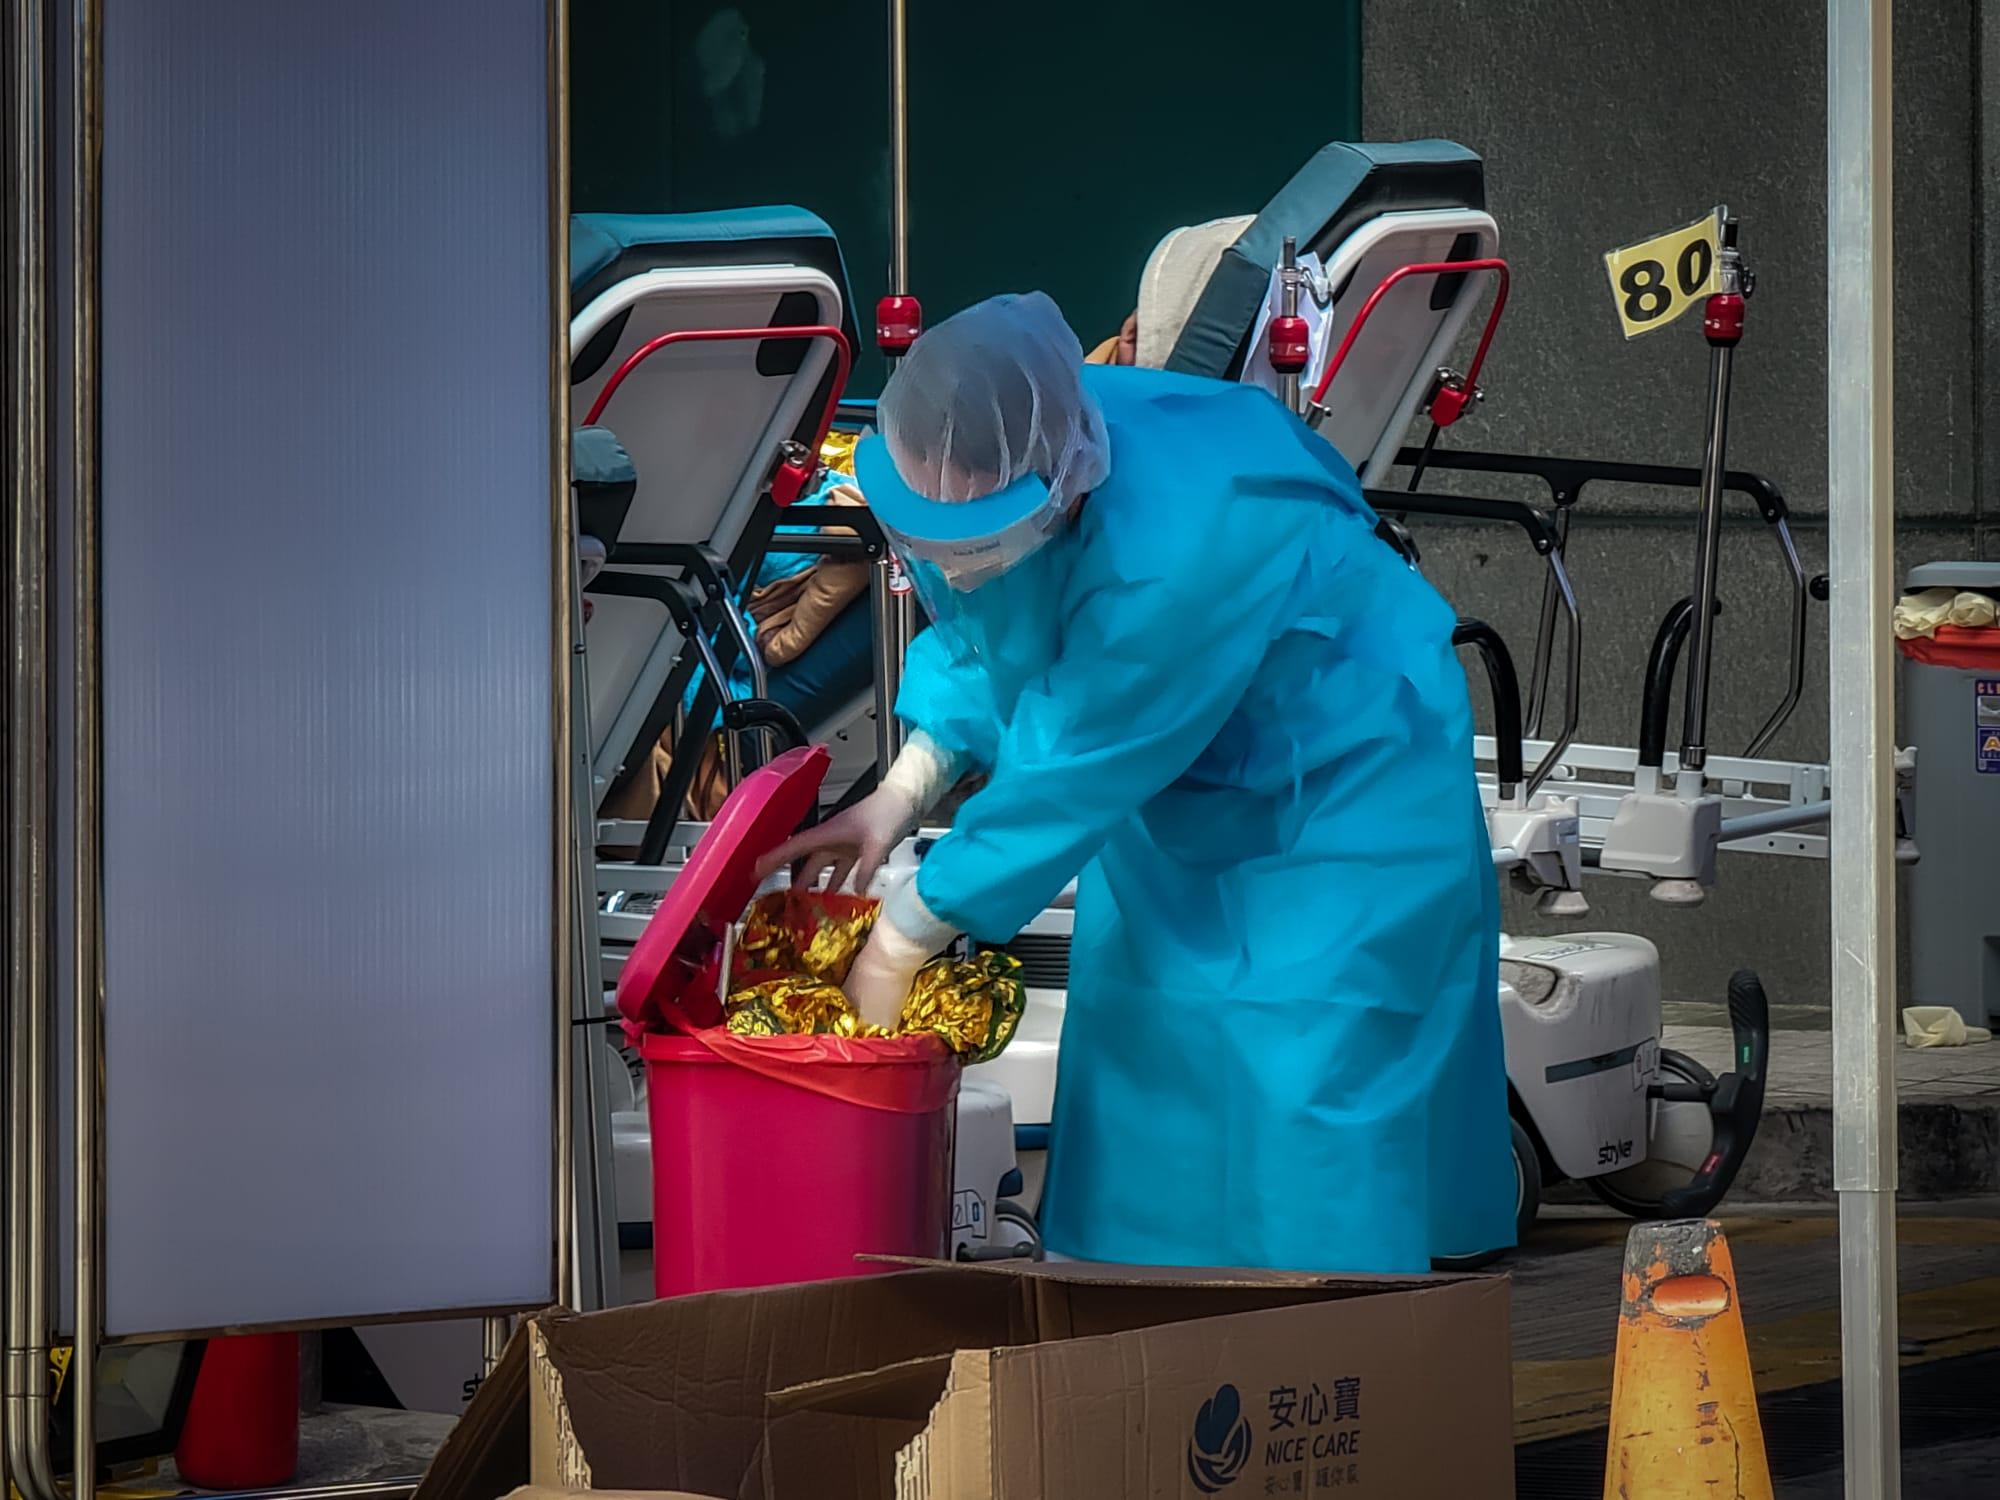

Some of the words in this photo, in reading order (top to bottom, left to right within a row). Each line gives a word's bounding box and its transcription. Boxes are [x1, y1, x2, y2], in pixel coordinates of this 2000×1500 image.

[1619, 238, 1713, 322] 80
[1269, 1376, 1360, 1432] 安心寶
[1265, 1437, 1307, 1466] NICE
[1312, 1430, 1361, 1459] CARE
